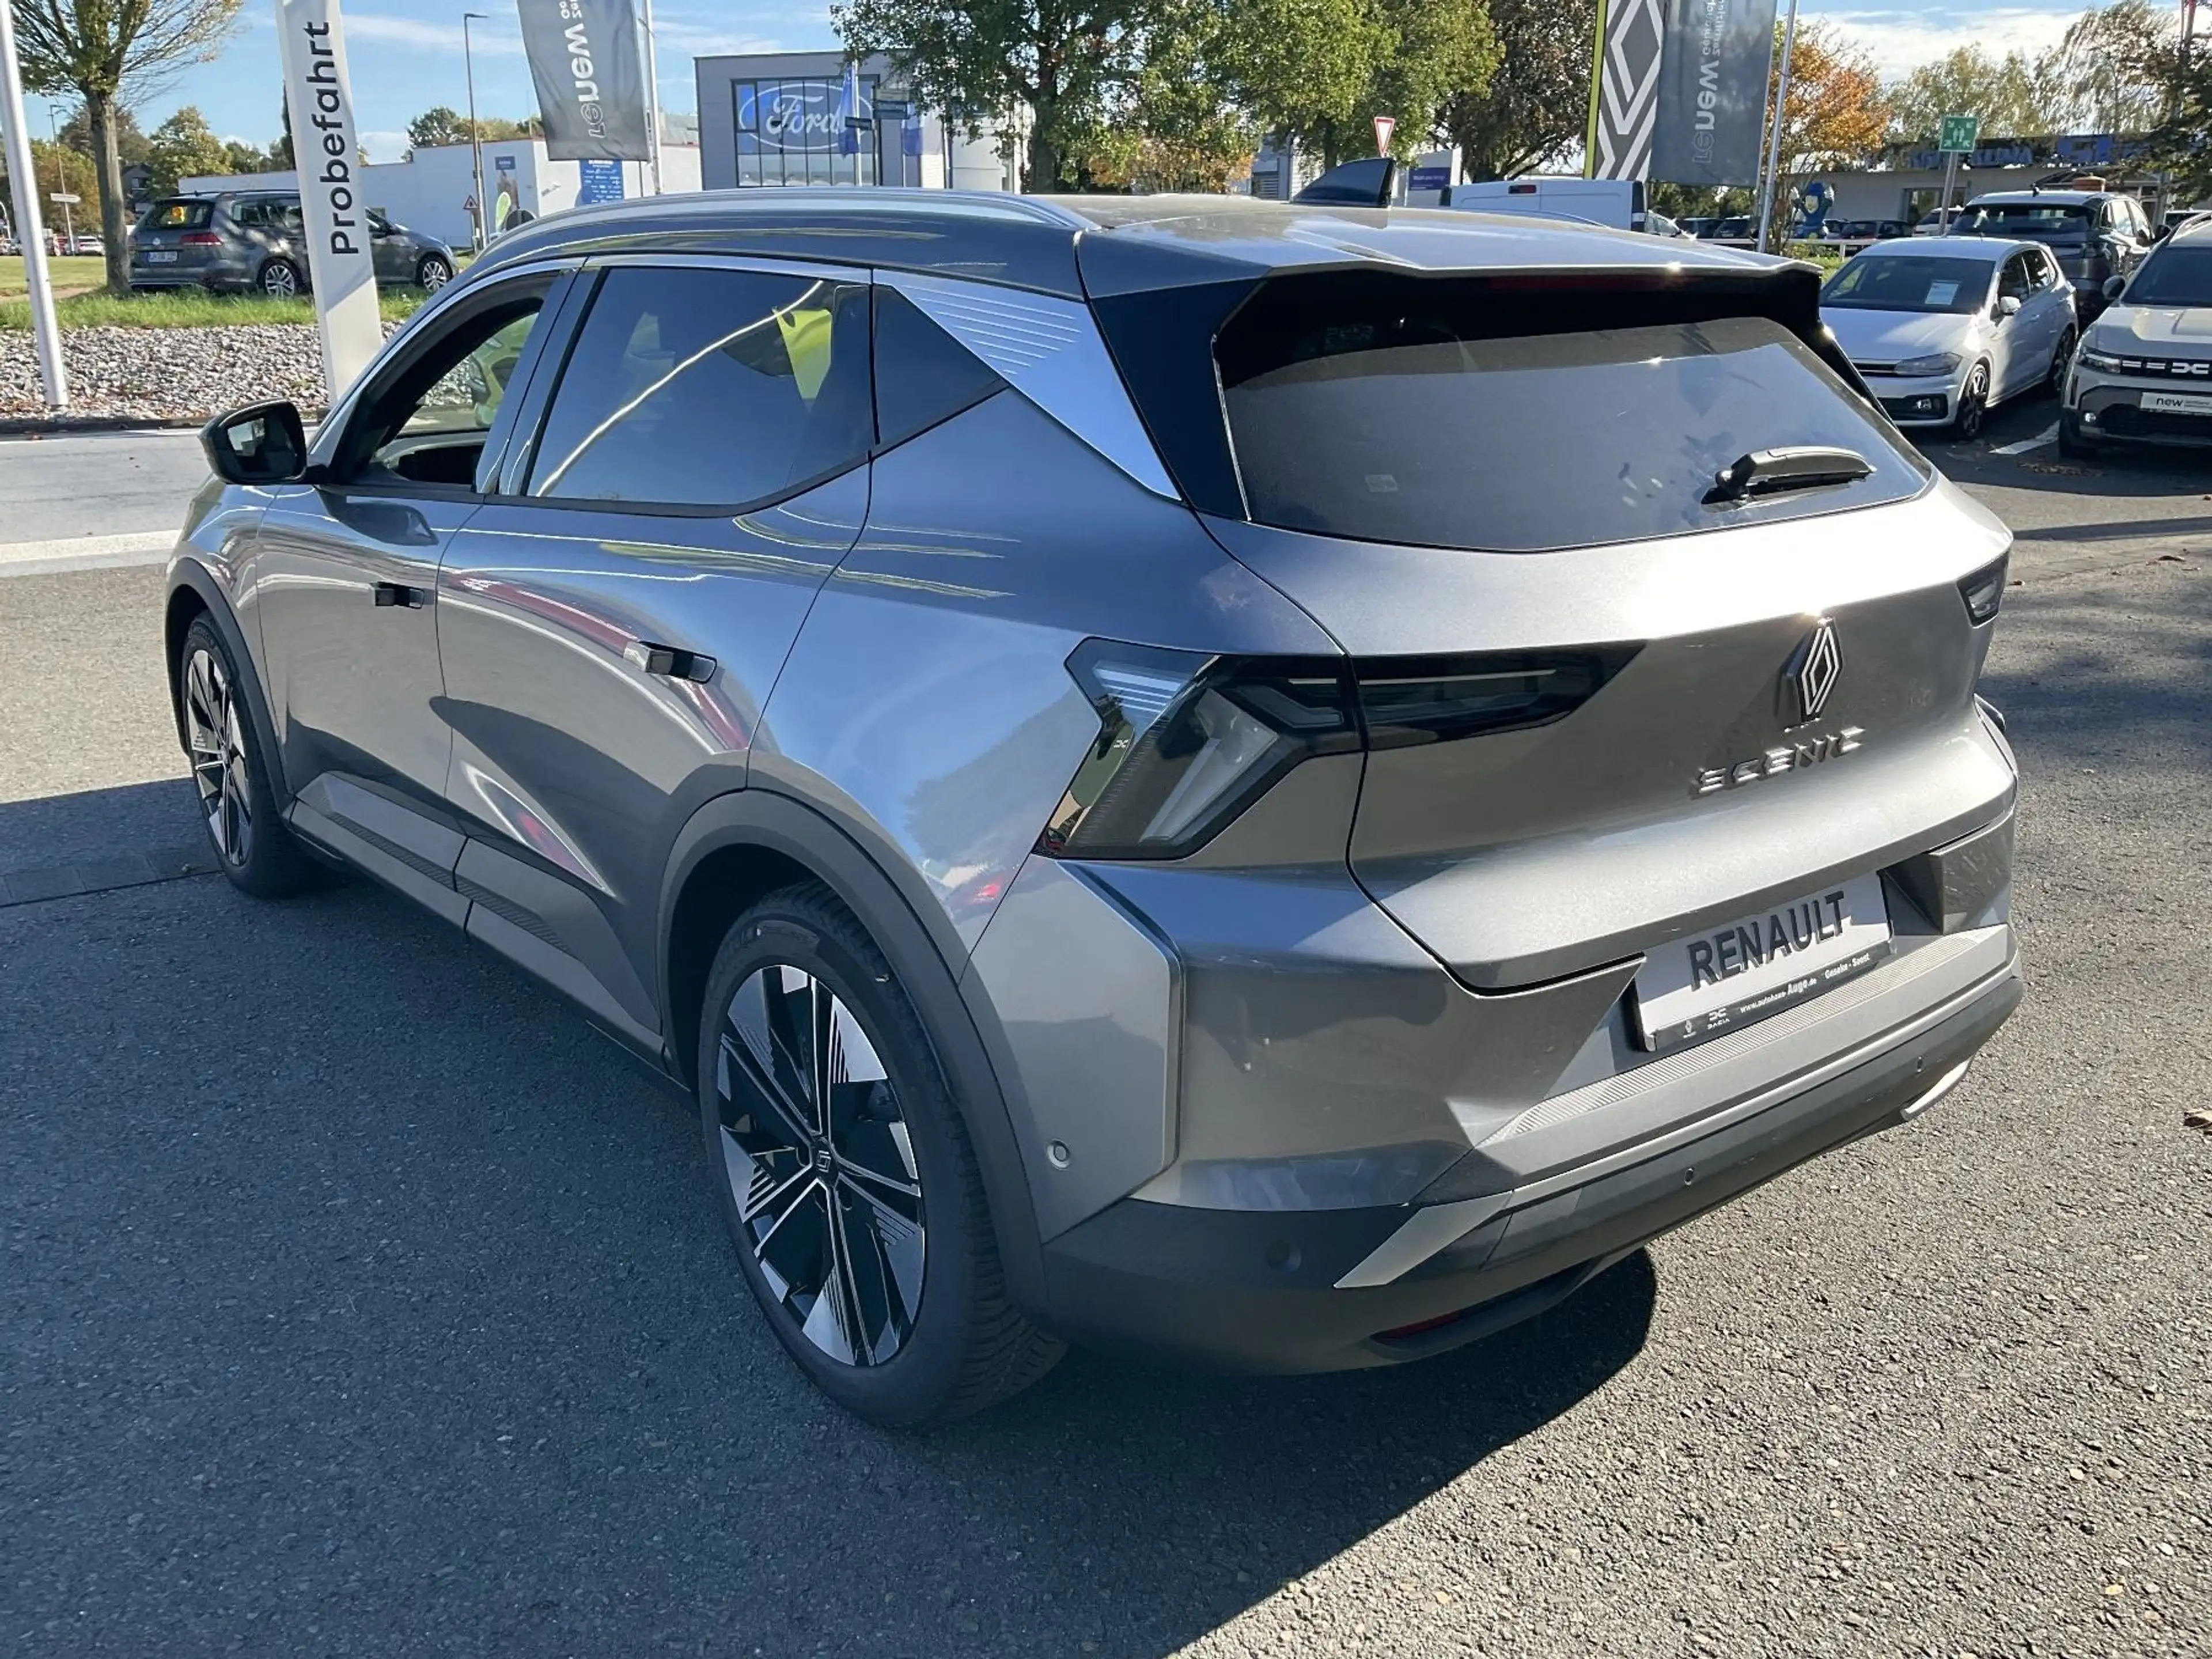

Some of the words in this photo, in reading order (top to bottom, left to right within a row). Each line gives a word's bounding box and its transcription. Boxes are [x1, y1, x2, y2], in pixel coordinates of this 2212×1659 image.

[304, 21, 359, 255] Probefahrt
[766, 94, 848, 135] Ford
[1696, 726, 1866, 795] SCENIC
[1687, 891, 1844, 991] RENAULT
[1707, 1018, 1730, 1030] DACIA
